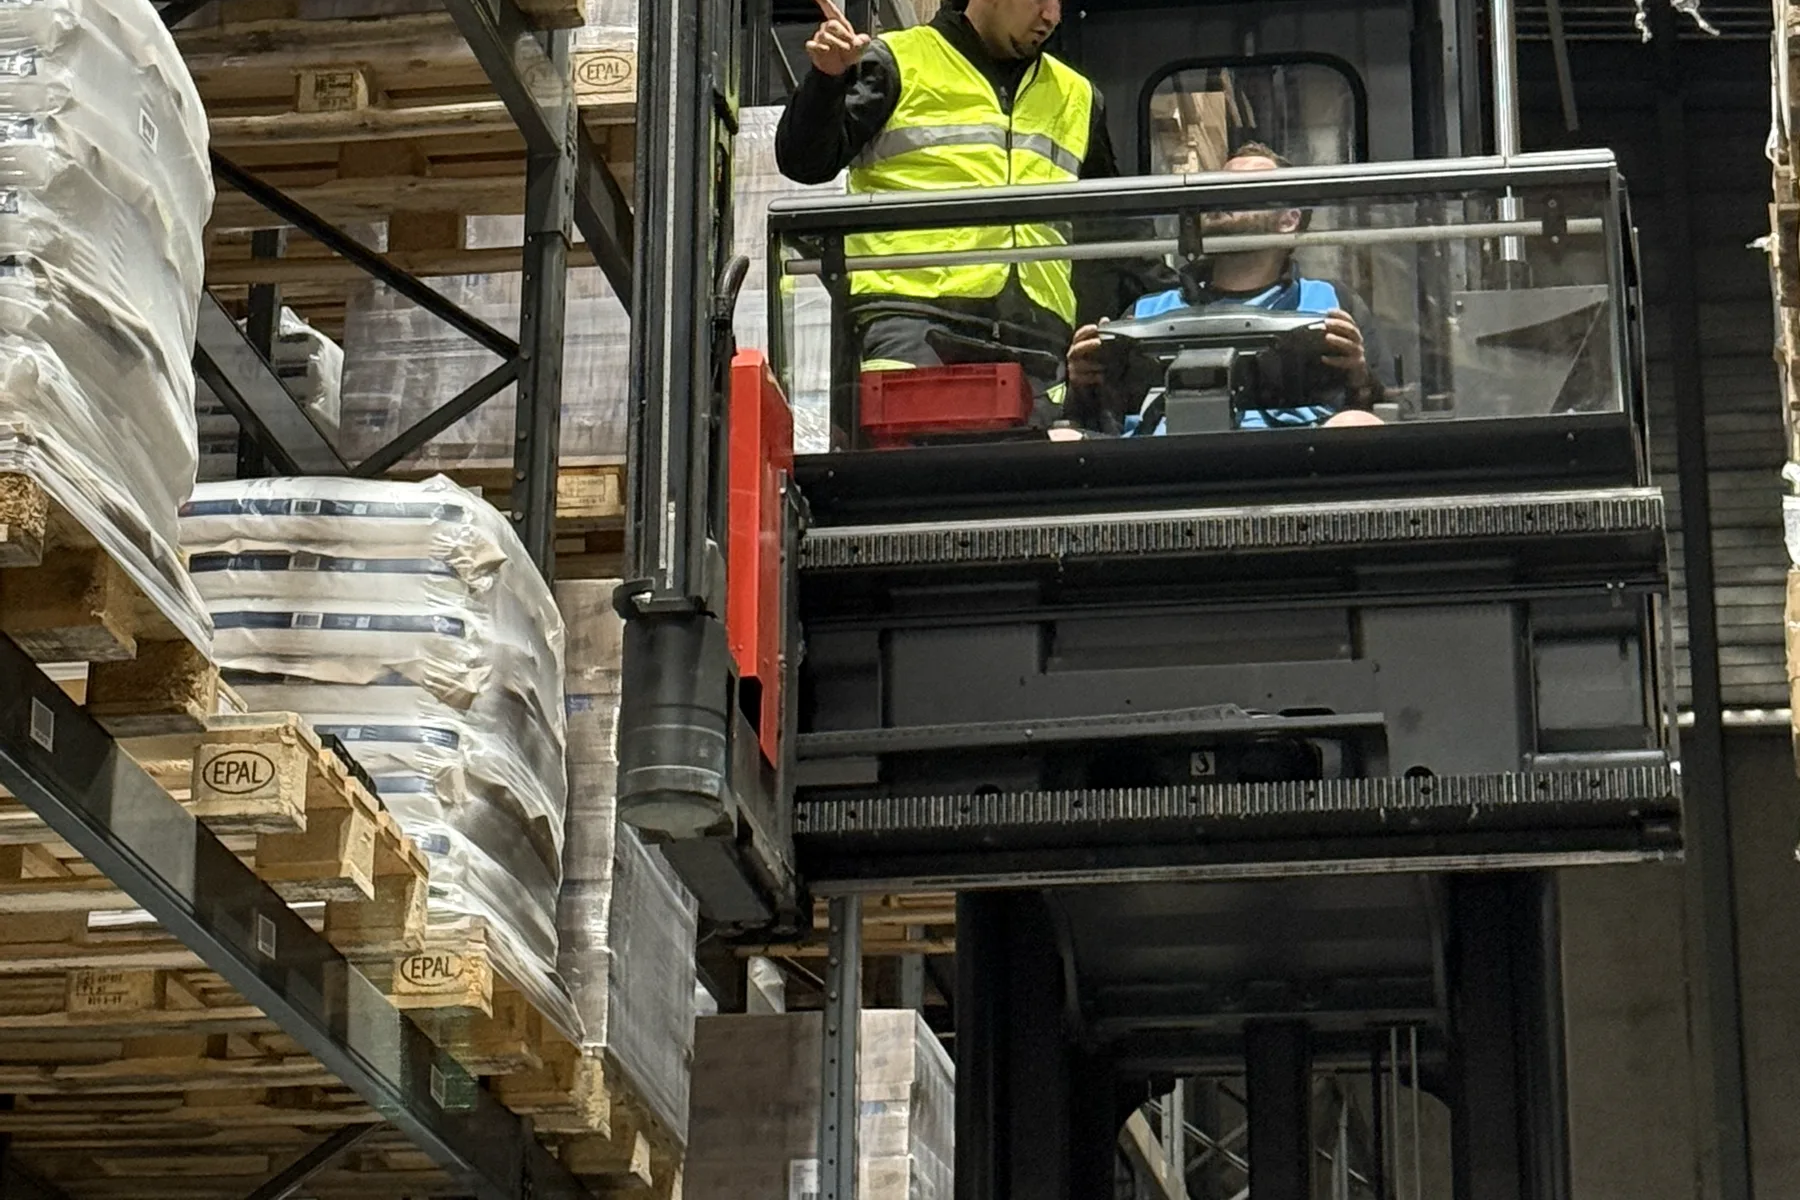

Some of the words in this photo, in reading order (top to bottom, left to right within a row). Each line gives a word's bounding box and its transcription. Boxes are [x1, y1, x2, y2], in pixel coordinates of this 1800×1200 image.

[587, 62, 624, 81] EPAL
[213, 760, 263, 785] EPAL
[410, 956, 455, 979] EPAL
